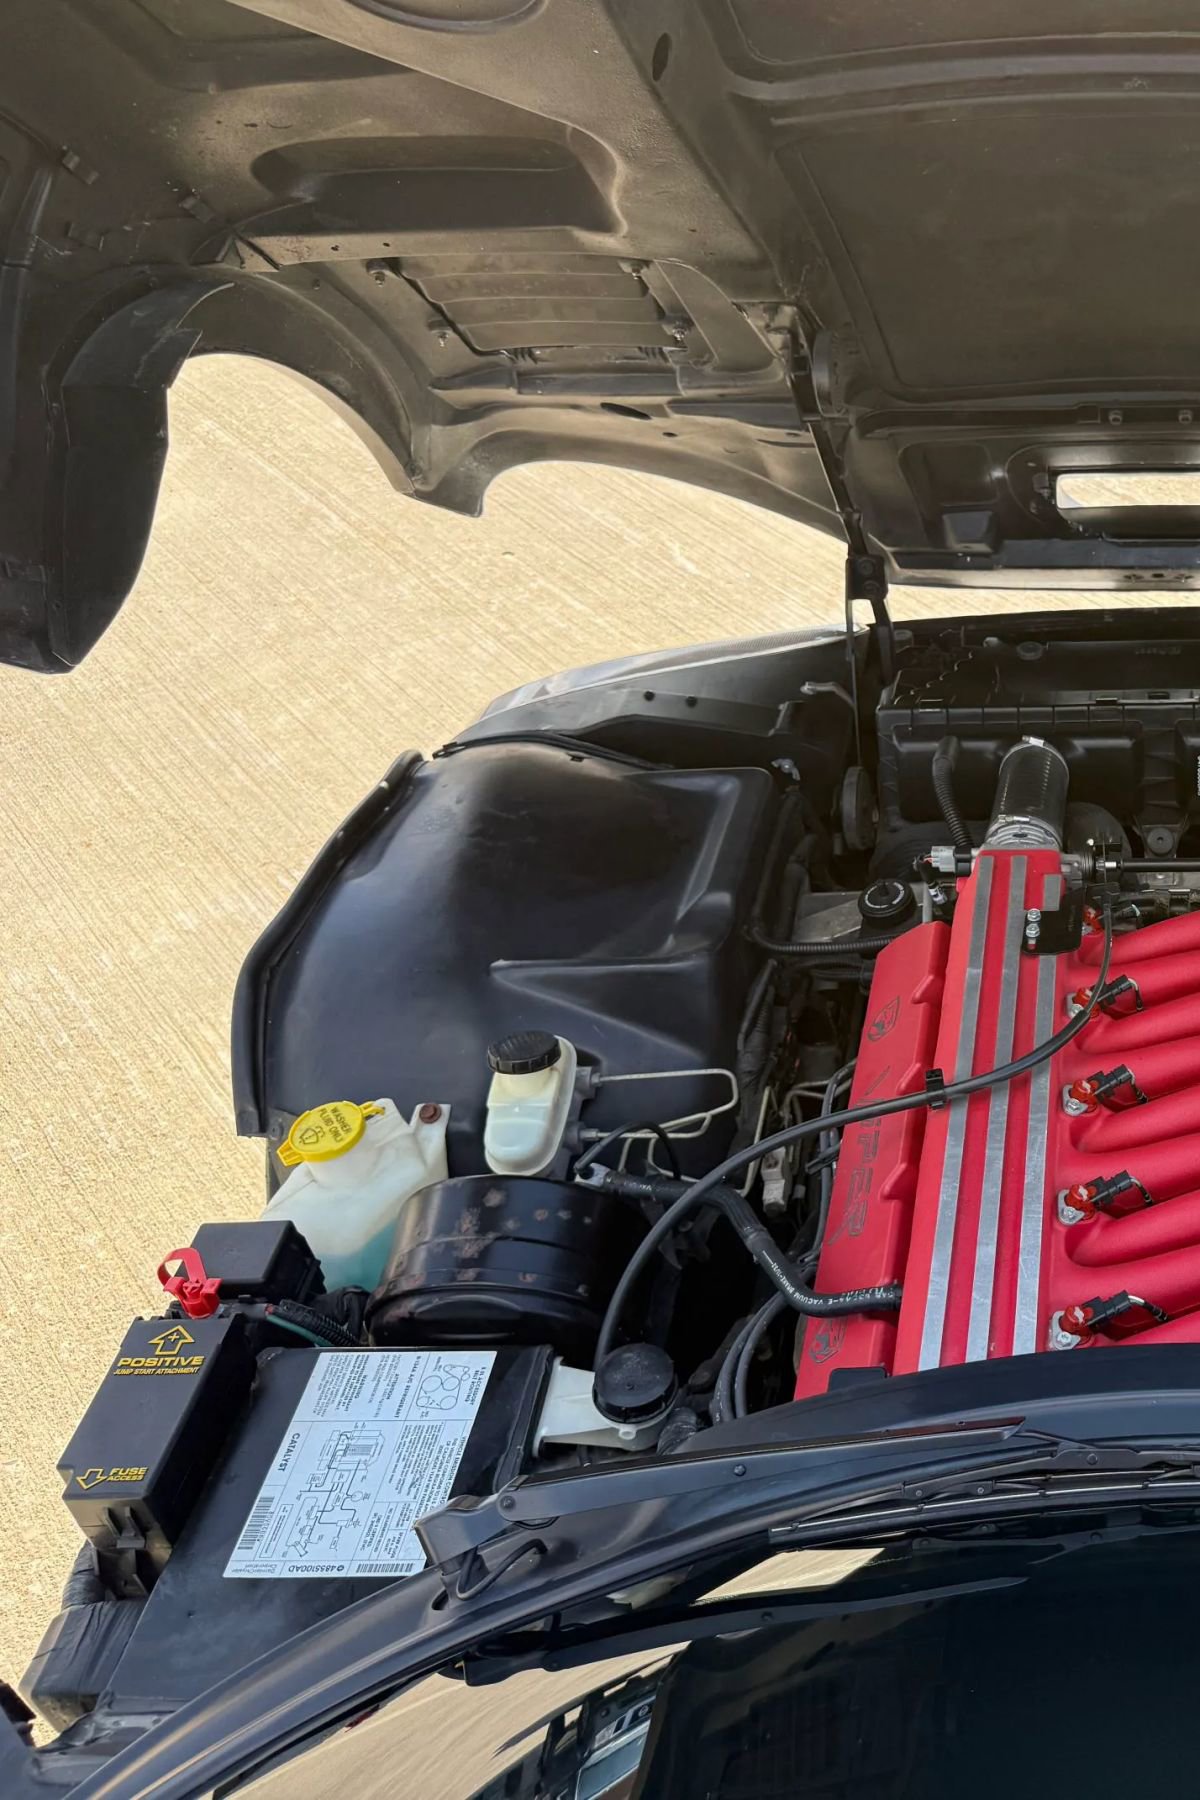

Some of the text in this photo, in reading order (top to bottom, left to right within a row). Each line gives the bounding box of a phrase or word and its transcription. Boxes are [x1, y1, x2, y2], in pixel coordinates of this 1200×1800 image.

[330, 1106, 353, 1135] WASHER
[117, 1356, 205, 1367] POSITIVE
[155, 1367, 200, 1375] ATTACHMENT
[276, 1432, 301, 1472] CATALYST
[109, 1467, 148, 1476] FUSE
[289, 1564, 337, 1573] 4855100AD
